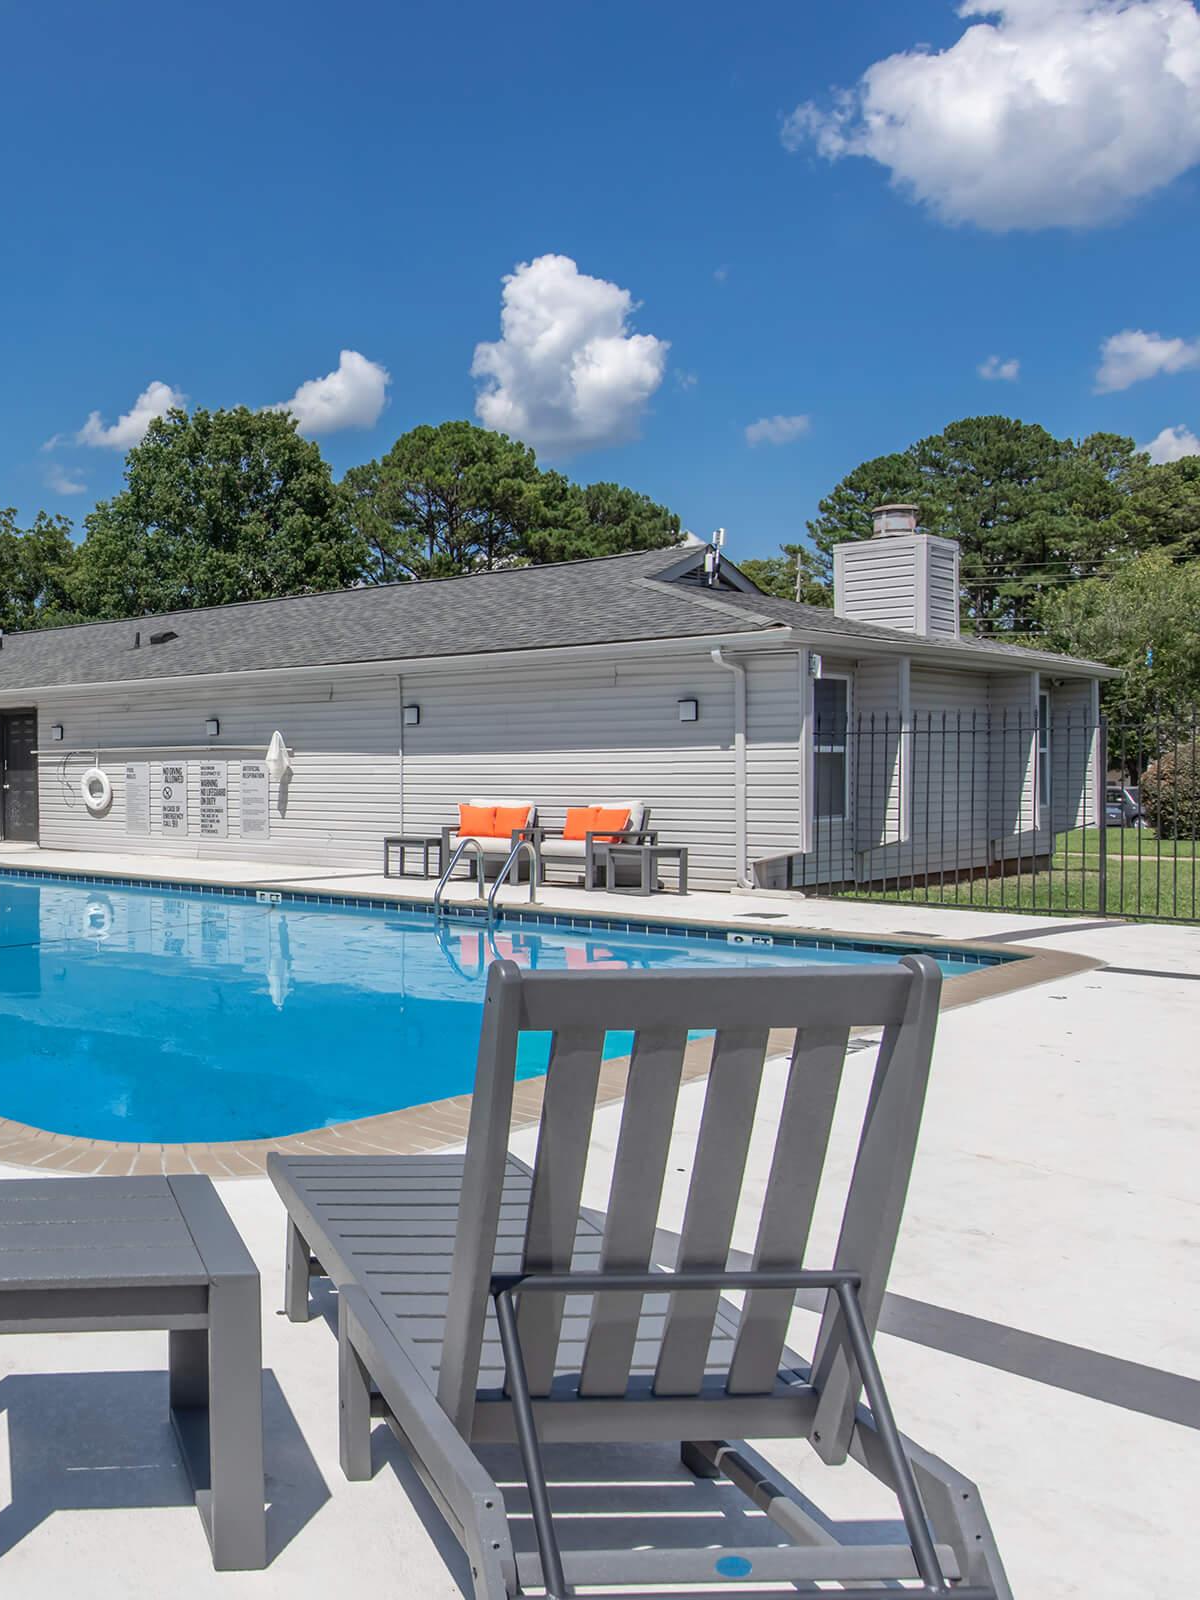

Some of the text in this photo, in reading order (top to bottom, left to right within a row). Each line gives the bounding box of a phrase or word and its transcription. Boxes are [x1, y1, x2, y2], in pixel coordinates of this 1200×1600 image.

[169, 767, 183, 776] DIVING
[200, 779, 218, 787] WARNING
[200, 788, 226, 796] NO LIFEGUARD
[200, 797, 216, 805] ON DUTY
